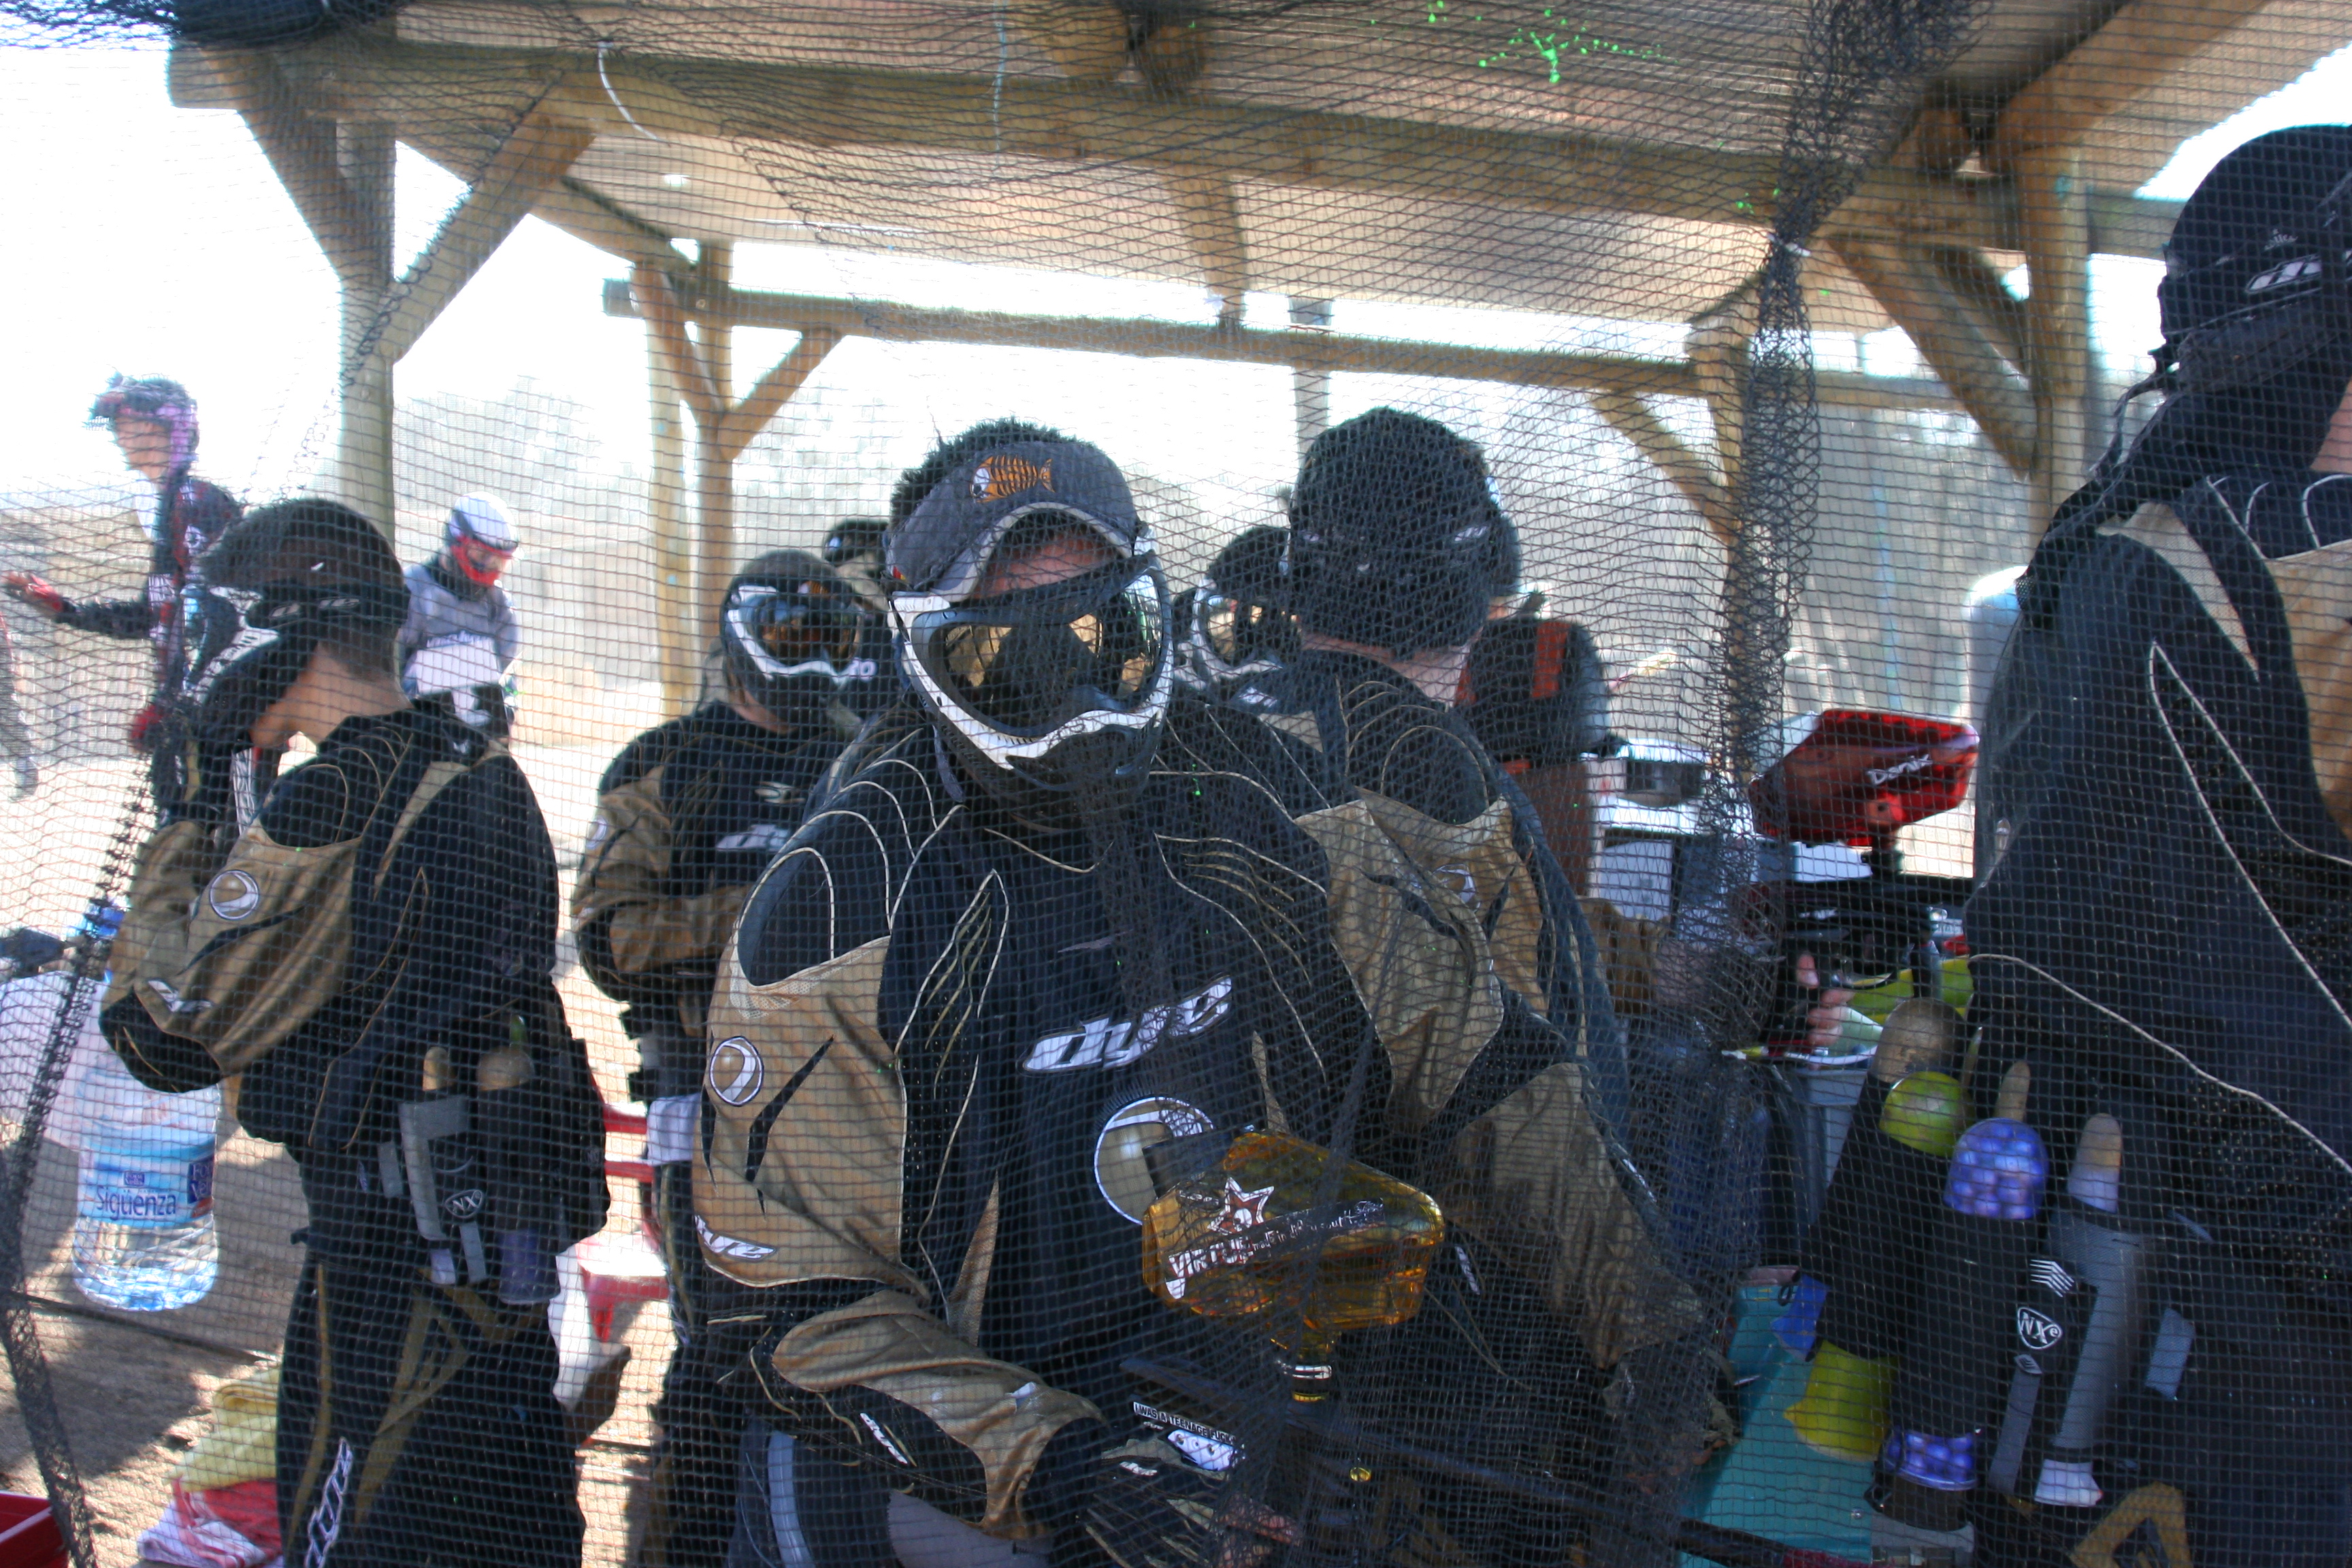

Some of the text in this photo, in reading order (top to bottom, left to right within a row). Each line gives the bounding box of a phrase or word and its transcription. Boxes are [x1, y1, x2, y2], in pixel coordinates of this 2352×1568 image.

[97, 1186, 176, 1220] Sigüenza
[1140, 1404, 1157, 1419] WAS
[1170, 1416, 1208, 1437] TEENAGE
